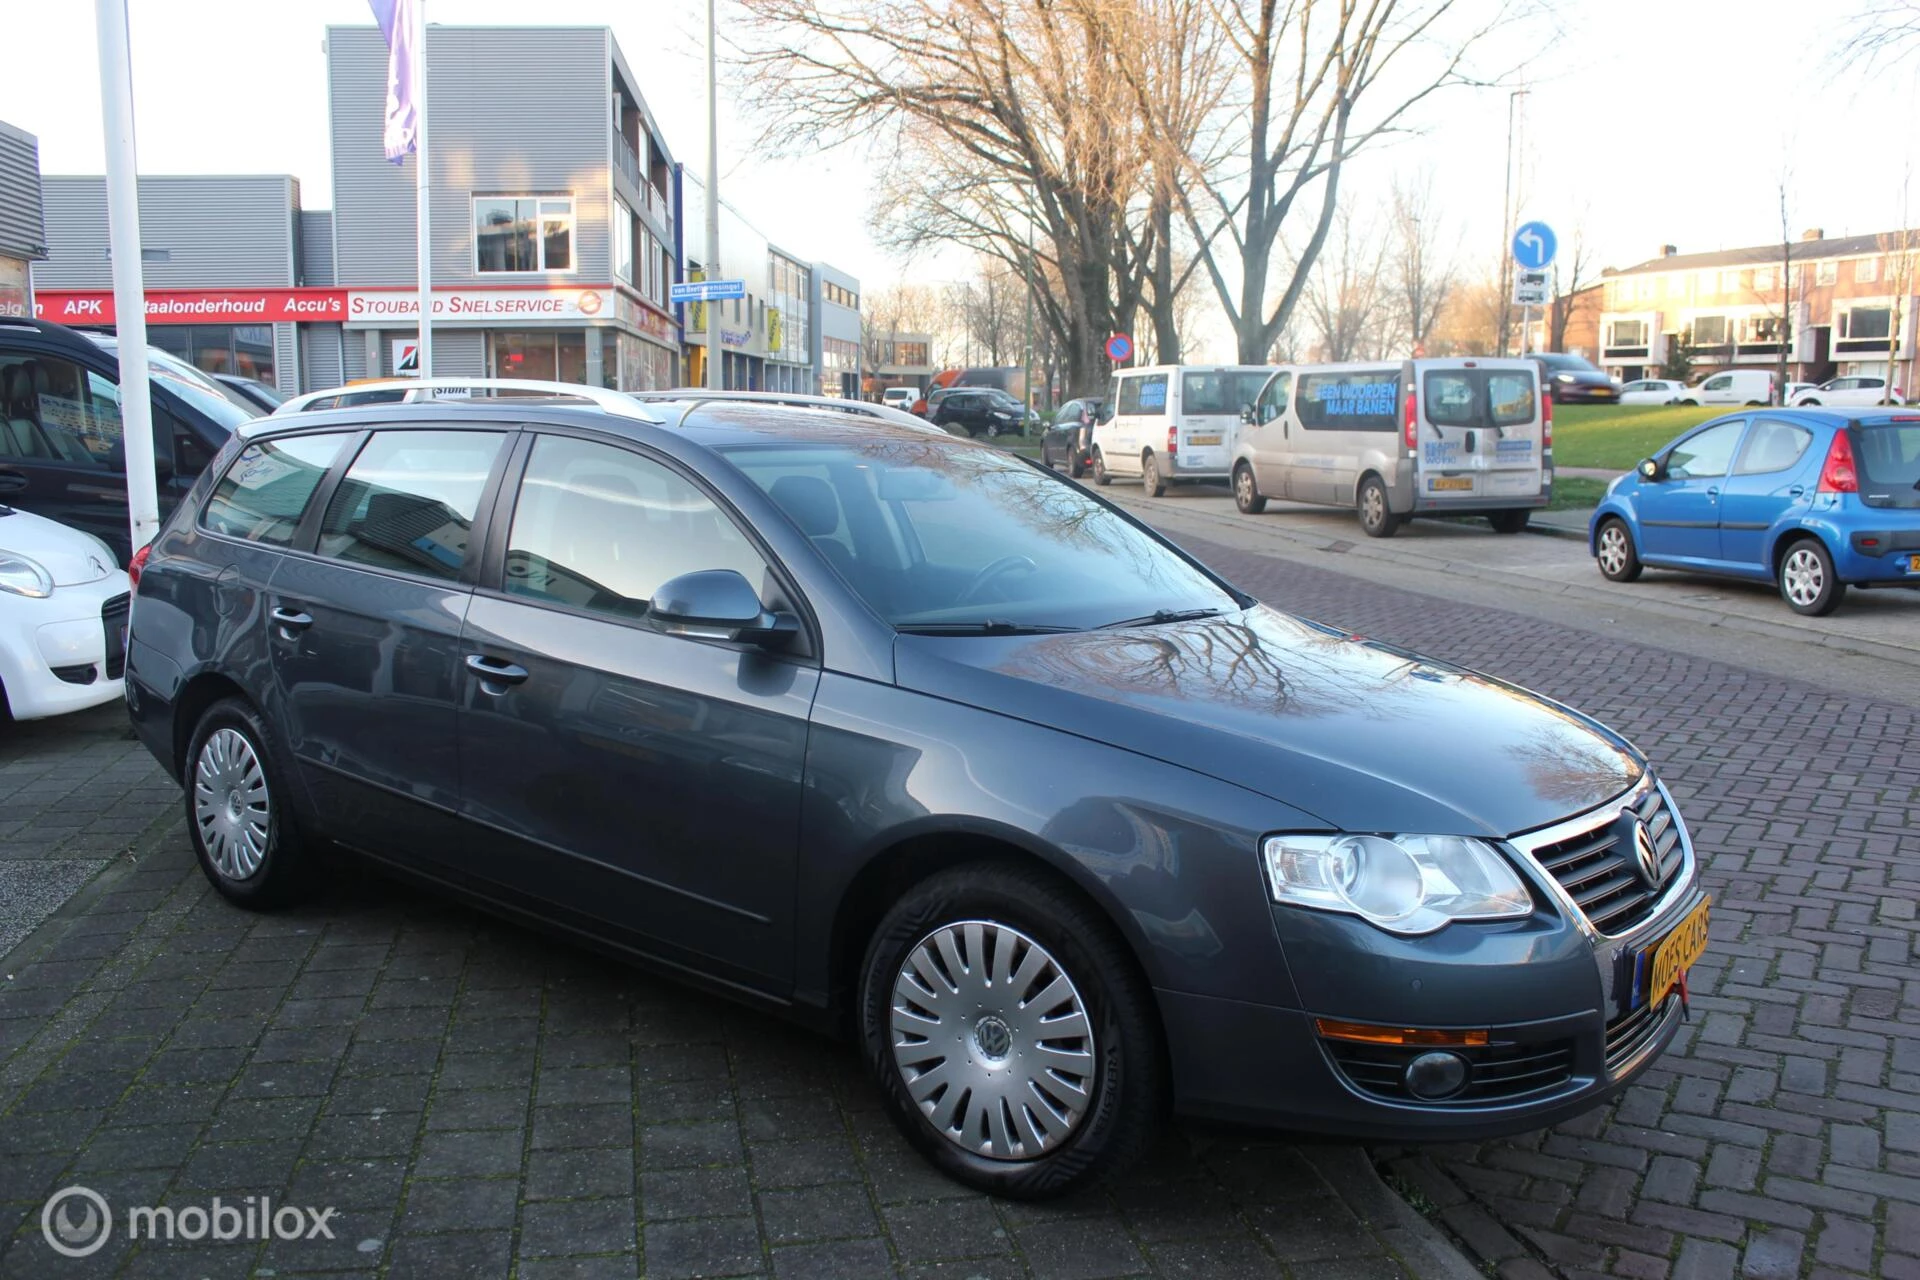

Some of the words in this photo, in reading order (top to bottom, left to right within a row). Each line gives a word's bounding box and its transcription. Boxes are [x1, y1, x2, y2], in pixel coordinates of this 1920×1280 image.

[64, 299, 102, 315] APK
[284, 297, 341, 313] Accu's
[352, 297, 443, 314] STOUBAD
[450, 296, 563, 313] SNELSERVICE
[1342, 383, 1396, 399] WOORDEN
[1326, 399, 1355, 415] MAAR
[1356, 399, 1395, 415] BANEN
[1652, 934, 1680, 1001] MOES
[1683, 904, 1710, 962] CARS
